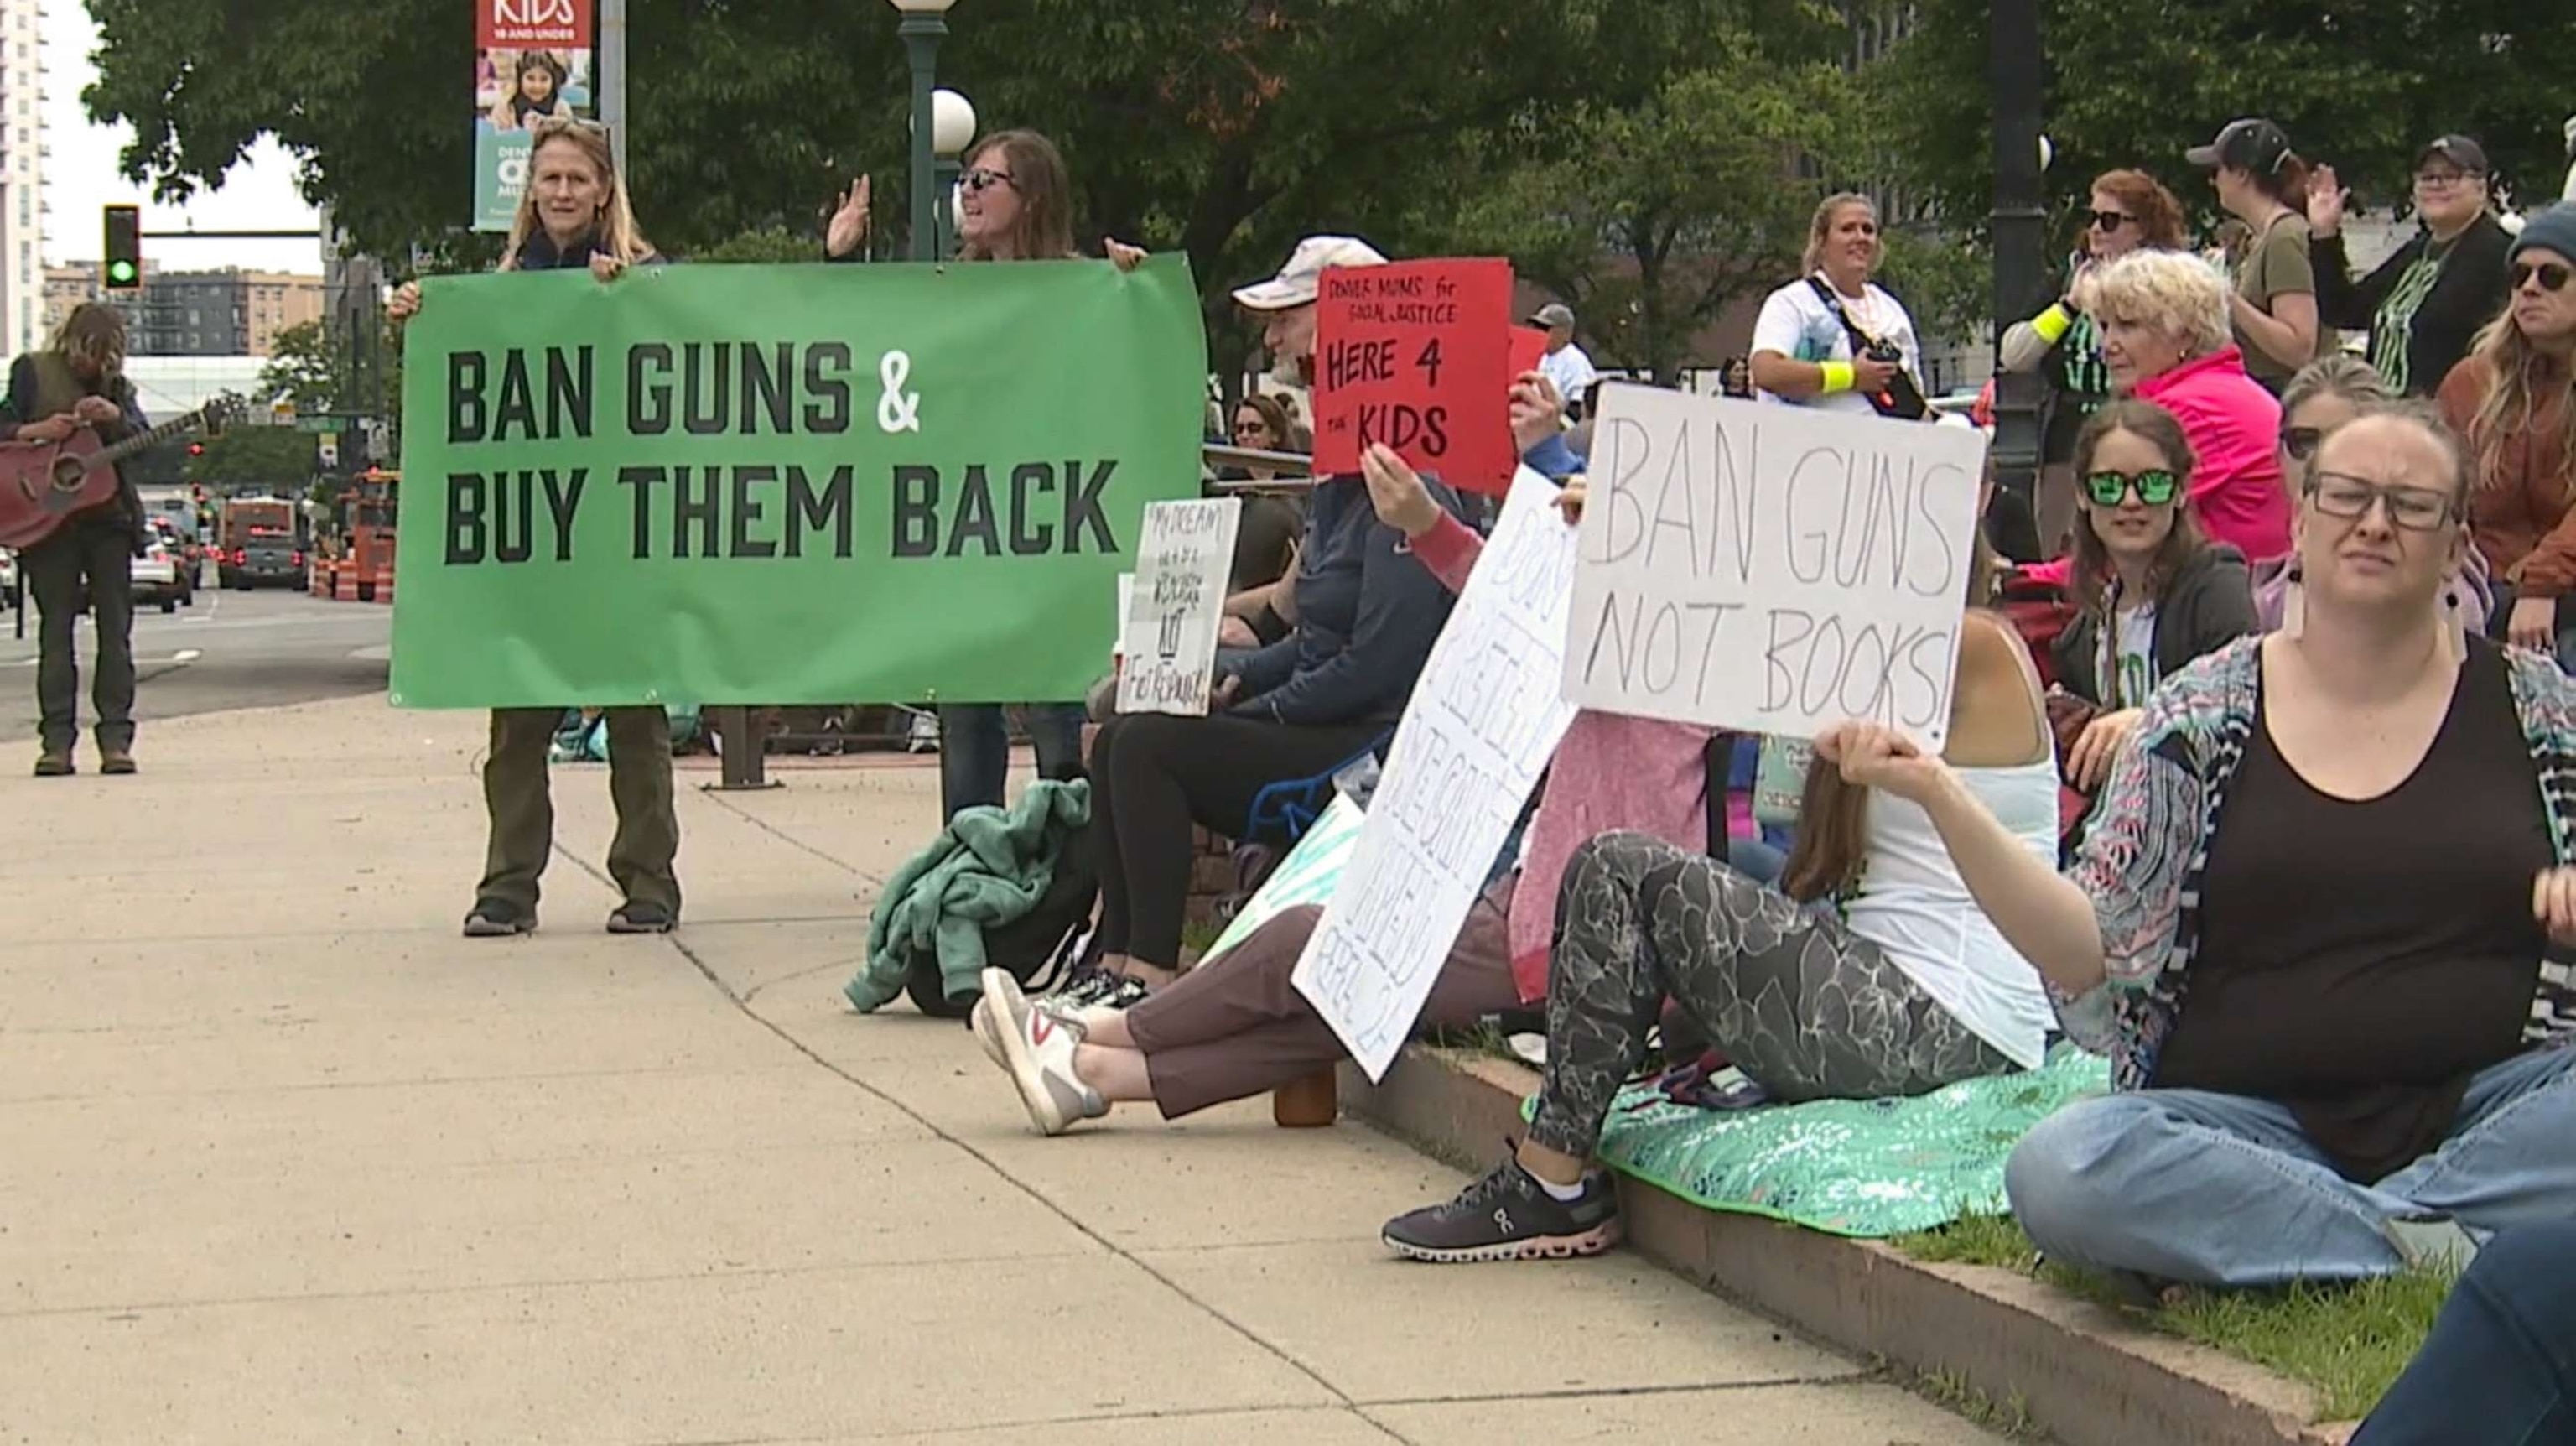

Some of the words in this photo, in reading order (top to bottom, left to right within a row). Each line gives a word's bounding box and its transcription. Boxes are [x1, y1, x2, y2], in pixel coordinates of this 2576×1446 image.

[508, 28, 534, 40] AND
[535, 28, 574, 40] UNDER
[498, 147, 532, 159] DEN
[1389, 303, 1458, 325] JUSTICE
[447, 345, 593, 445] BAN
[626, 341, 851, 436] GUNS
[877, 349, 921, 434] &
[1327, 338, 1398, 393] HERE
[1415, 337, 1442, 388] 4
[1358, 403, 1448, 458] KIDS
[444, 467, 590, 566] BUY
[617, 465, 854, 559] THEM
[891, 459, 1120, 559] BACK
[1589, 417, 1758, 583] BAN
[1786, 446, 1965, 596] GUNS
[1490, 507, 1575, 622] DON
[1586, 590, 1746, 706] NOT
[1758, 607, 1957, 740] BOOKS!
